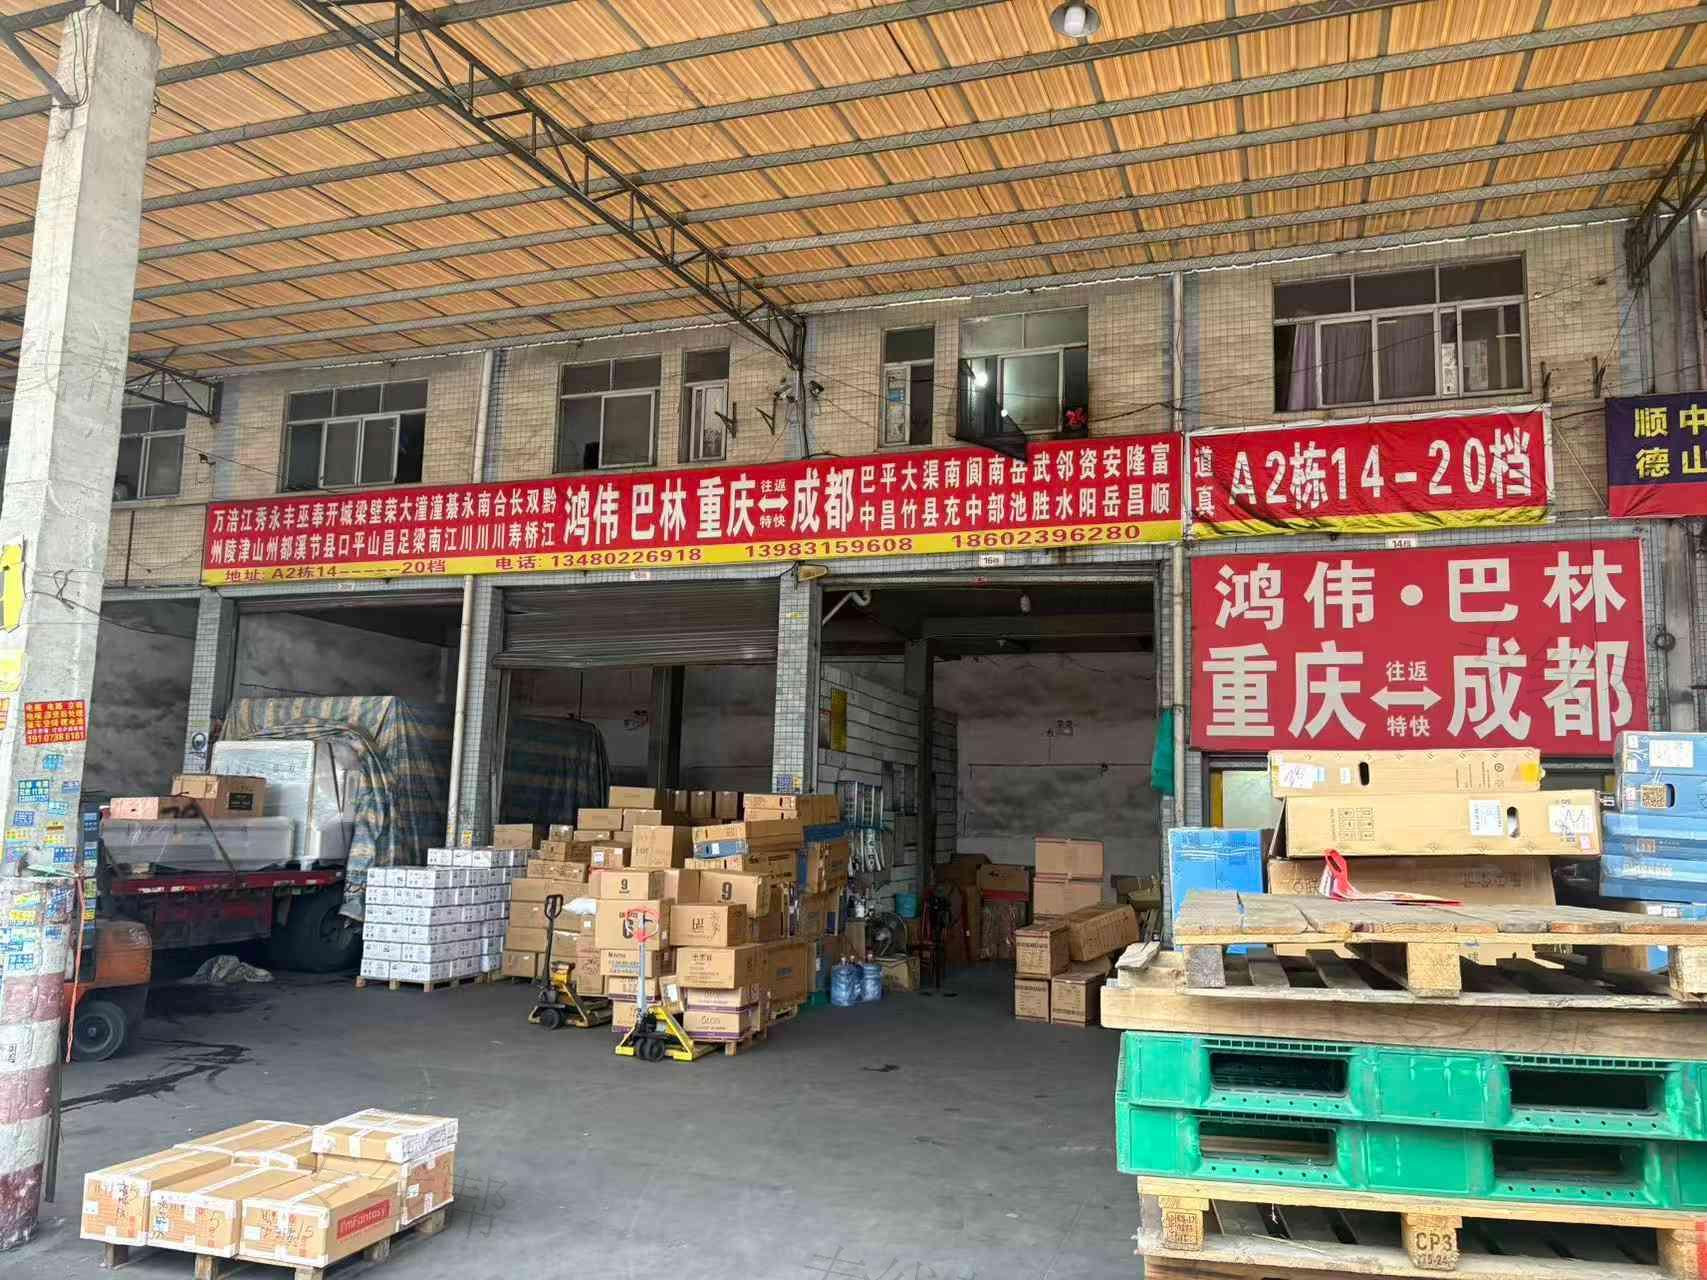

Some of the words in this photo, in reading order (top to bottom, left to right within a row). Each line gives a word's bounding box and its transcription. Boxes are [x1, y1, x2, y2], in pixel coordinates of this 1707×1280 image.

[760, 479, 787, 492] 往返
[697, 473, 756, 539] 重庆
[791, 466, 855, 533] 成都
[759, 513, 786, 528] 特快
[551, 547, 702, 567] 13480226918
[745, 537, 914, 557] 13983159608
[951, 524, 1141, 549] 18602396280
[1385, 660, 1428, 683] 往返
[1202, 639, 1367, 740] 重庆
[1447, 636, 1633, 742] 成都
[1386, 715, 1431, 738] 特快
[1415, 1232, 1453, 1252] CP3
